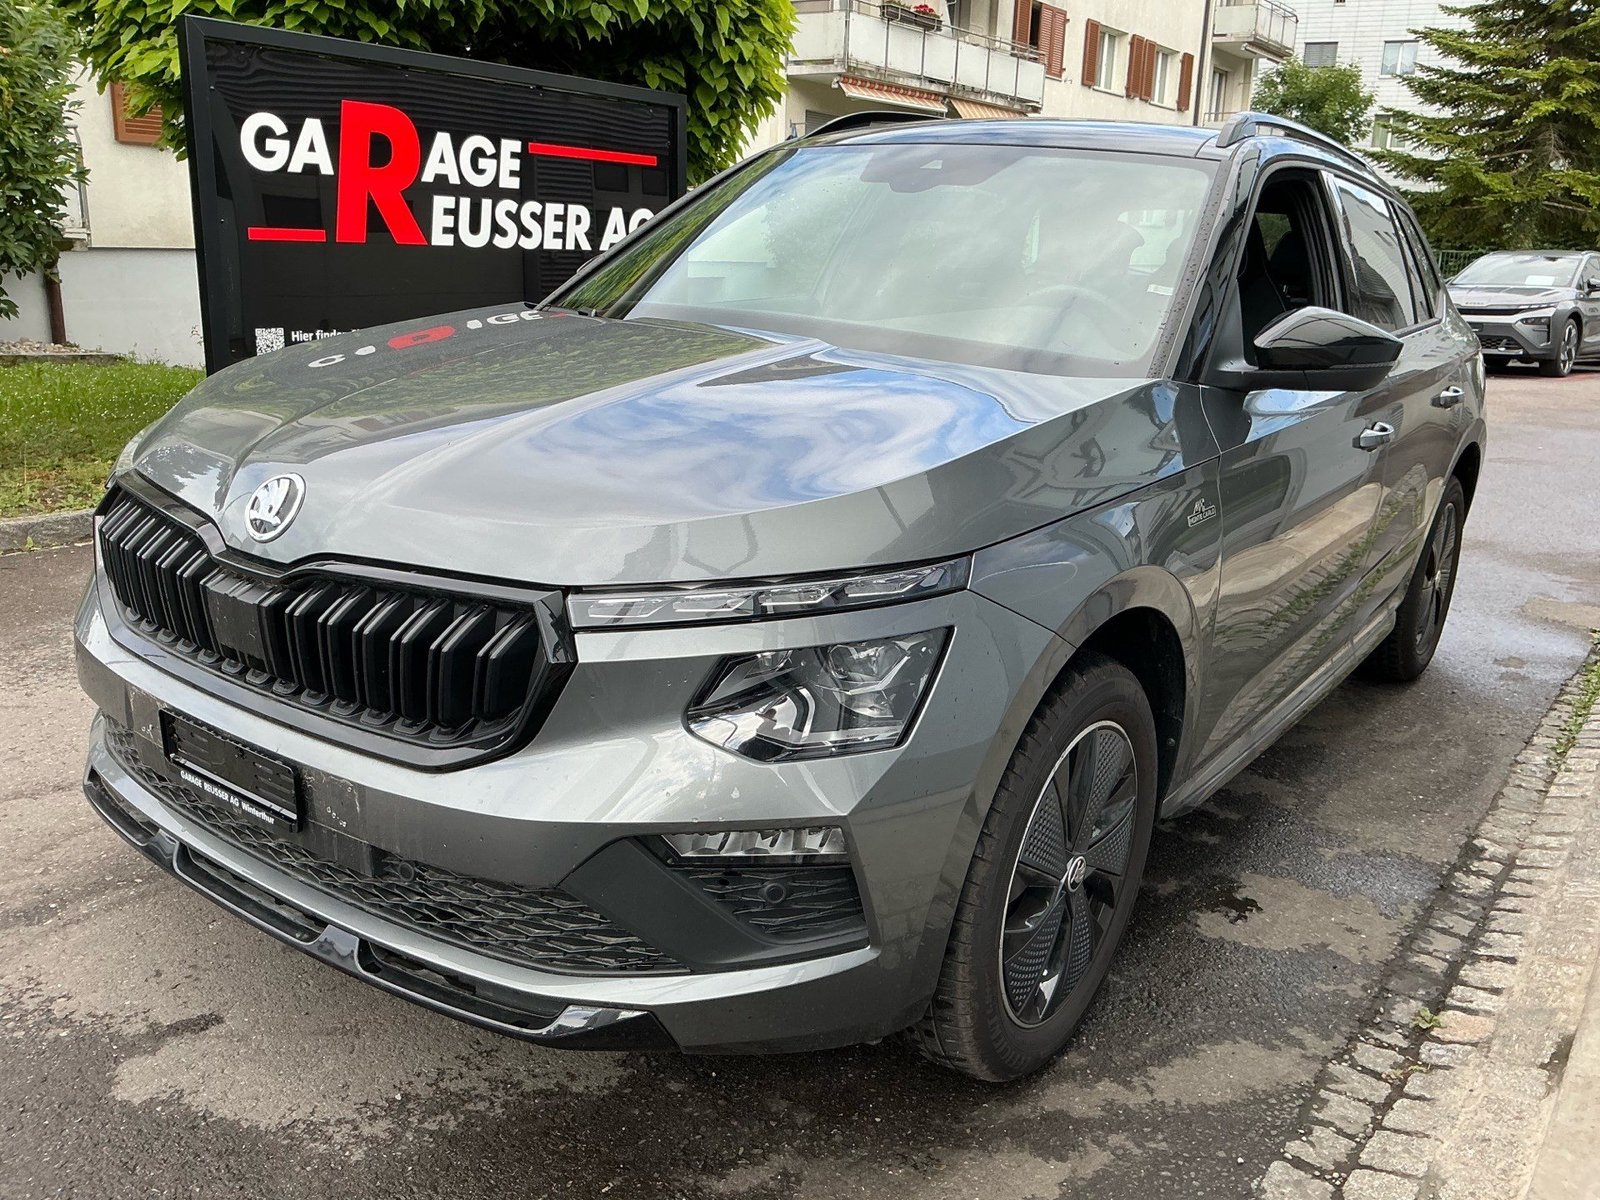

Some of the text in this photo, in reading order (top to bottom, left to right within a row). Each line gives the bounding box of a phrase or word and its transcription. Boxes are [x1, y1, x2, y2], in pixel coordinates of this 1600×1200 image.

[240, 99, 522, 245] GARAGE
[291, 329, 345, 342] Hier find
[180, 770, 275, 825] GARAGE REUSSER AG Winterthur
